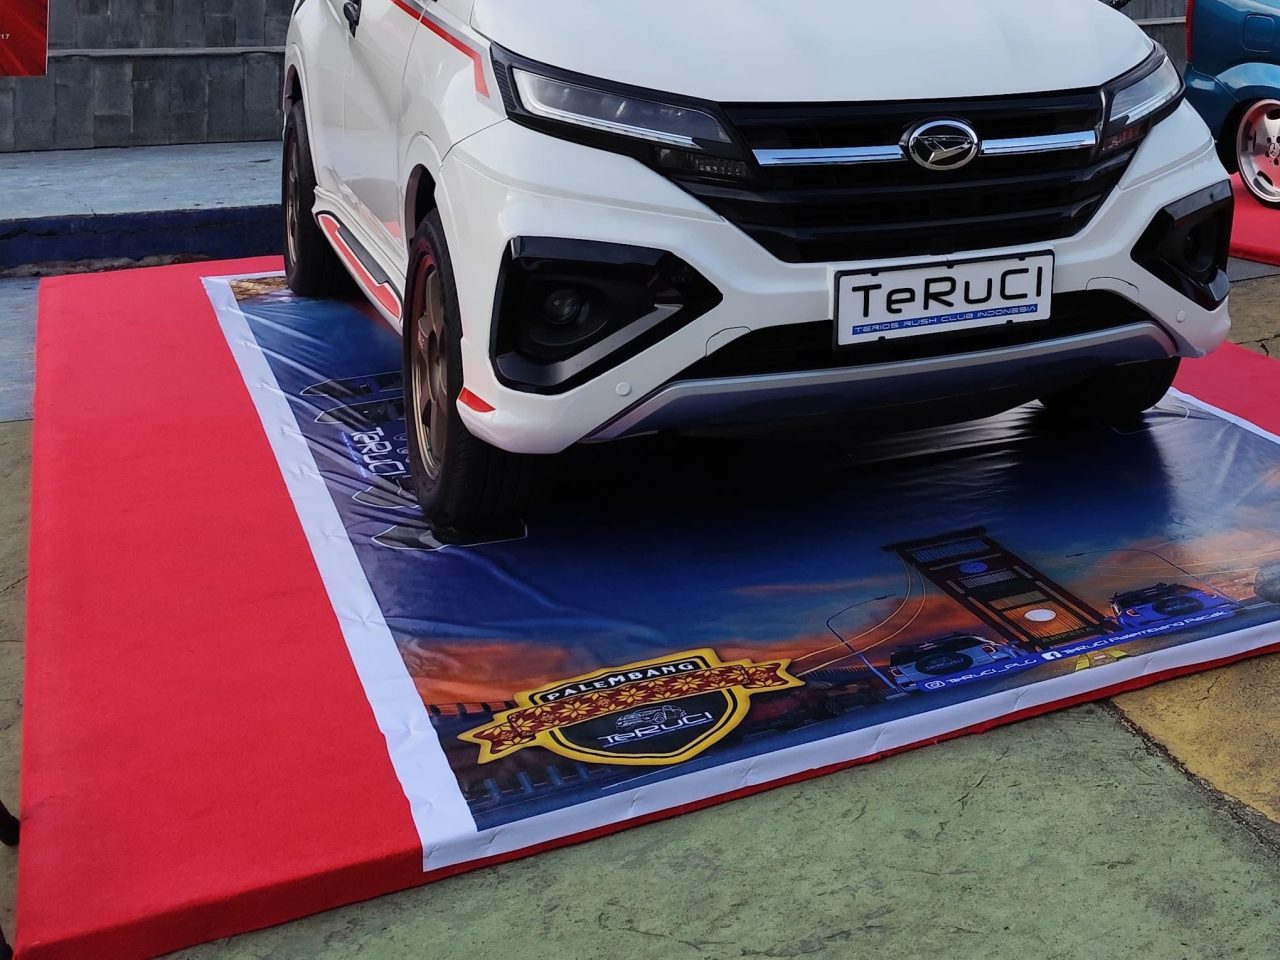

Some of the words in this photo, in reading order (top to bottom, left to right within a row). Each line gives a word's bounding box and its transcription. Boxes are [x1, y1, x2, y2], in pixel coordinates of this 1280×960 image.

[854, 321, 899, 334] TERIOS
[903, 317, 937, 328] RUSH
[941, 312, 974, 323] CLUB
[977, 305, 1037, 317] INDONESIA
[546, 662, 695, 701] PALEMBANG
